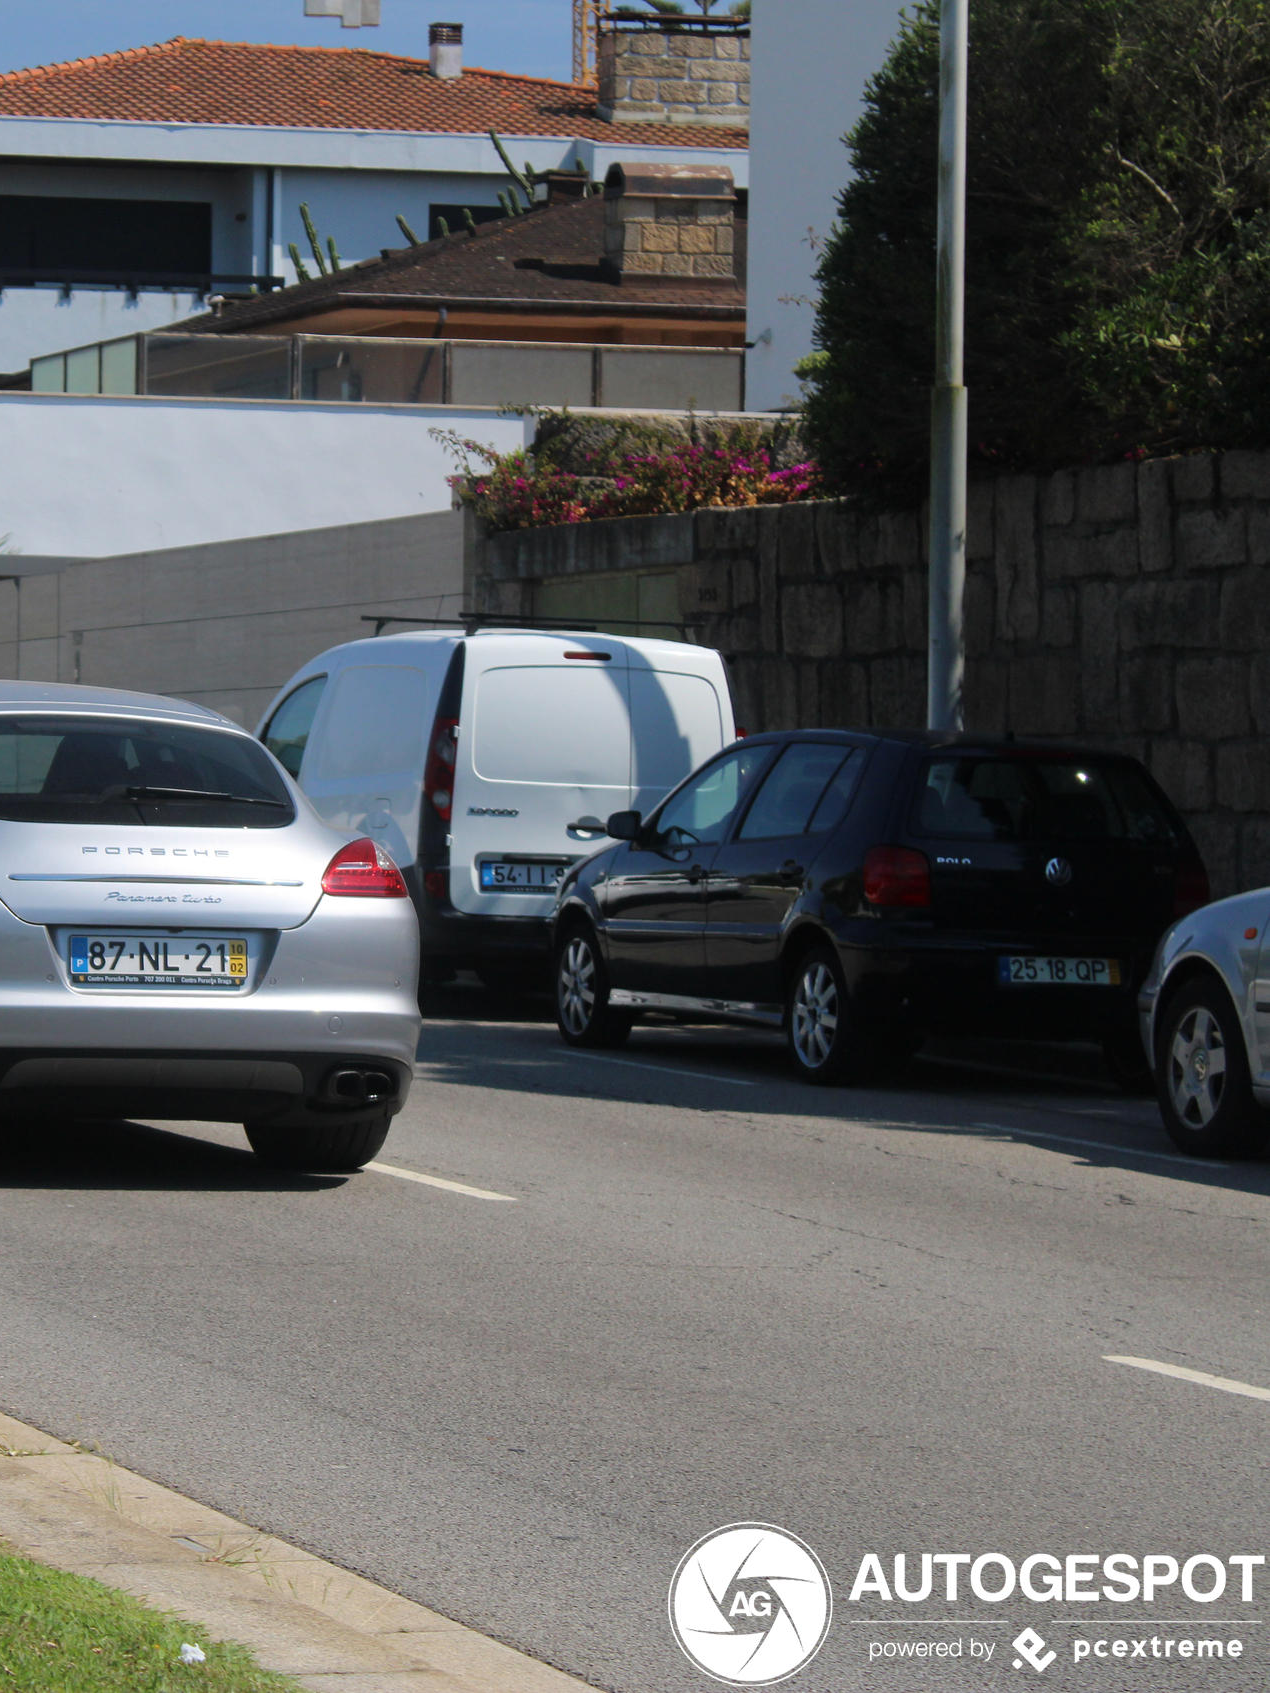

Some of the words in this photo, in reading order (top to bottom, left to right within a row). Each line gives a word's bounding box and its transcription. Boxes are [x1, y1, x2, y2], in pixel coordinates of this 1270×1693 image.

[82, 846, 230, 858] PORSCHE
[104, 891, 178, 903] Panamera
[231, 944, 243, 955] 10
[76, 959, 84, 968] P
[230, 963, 244, 973] 02
